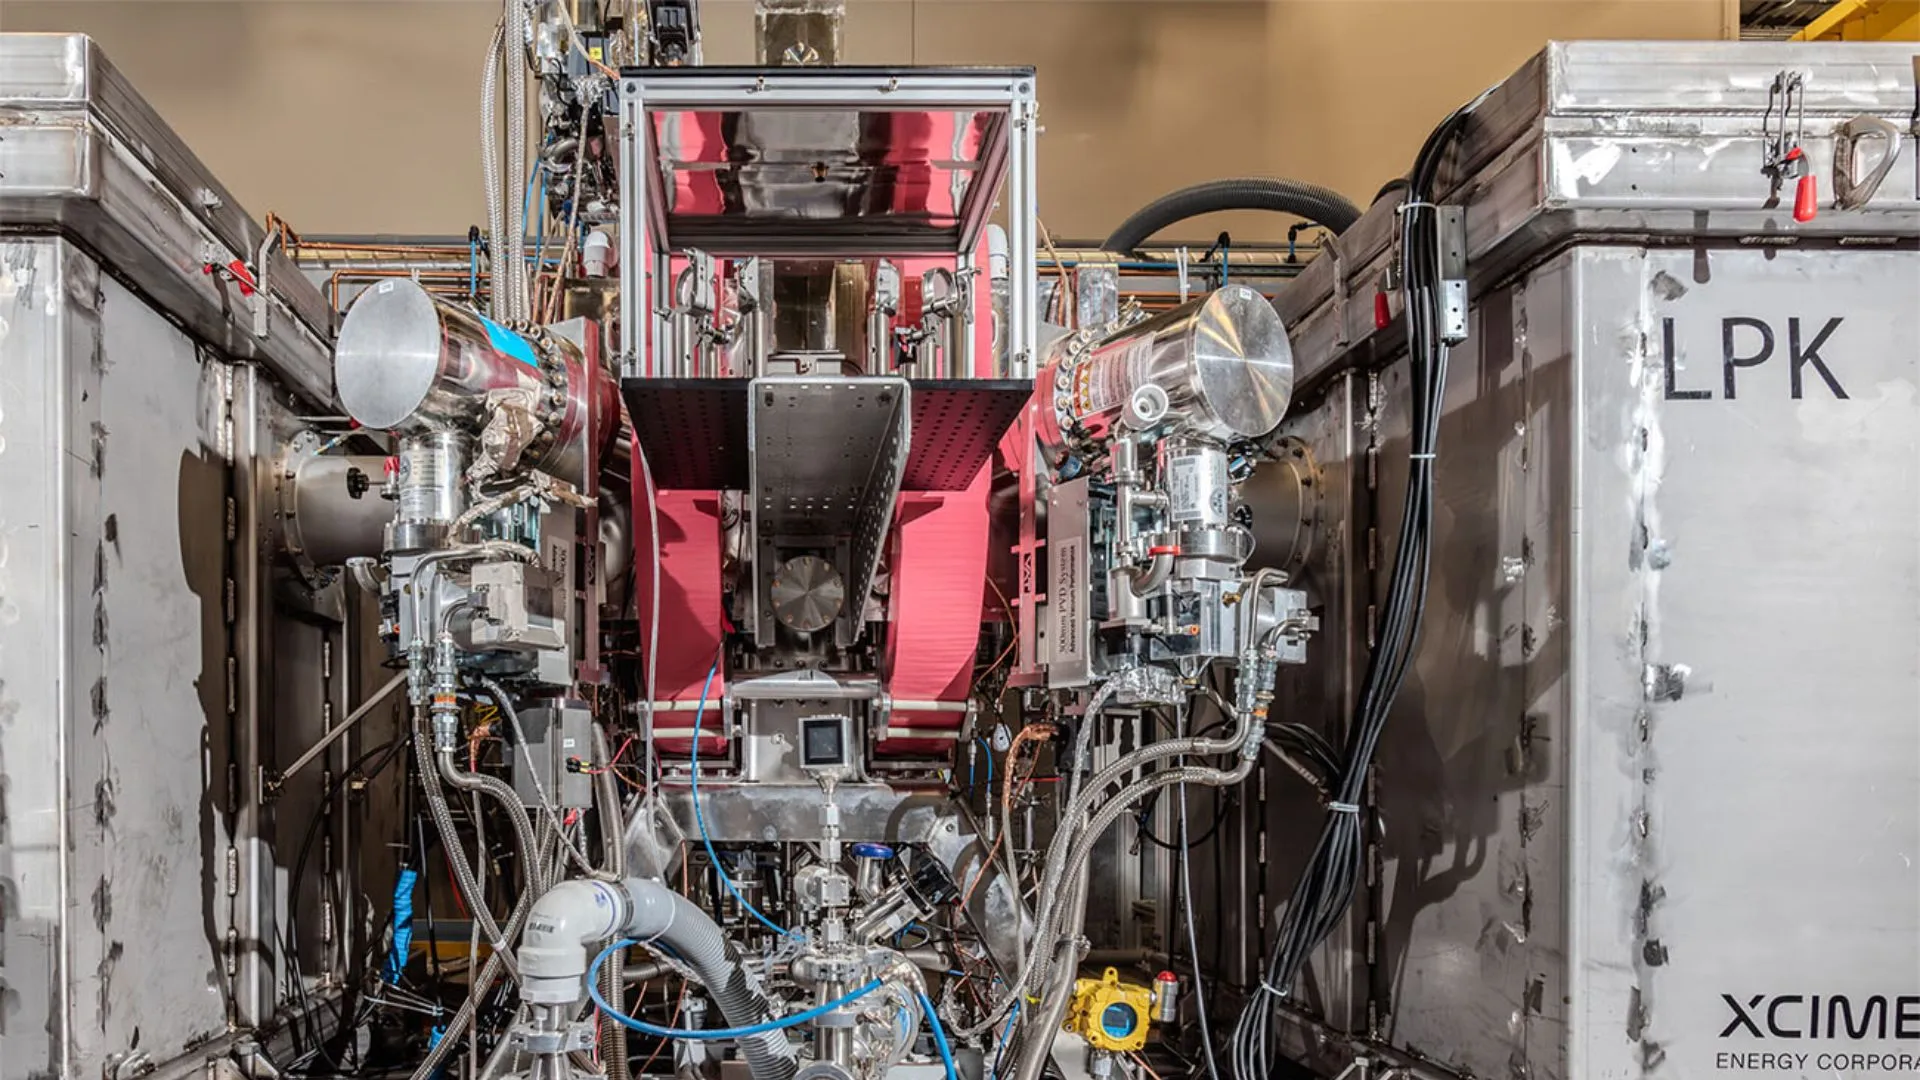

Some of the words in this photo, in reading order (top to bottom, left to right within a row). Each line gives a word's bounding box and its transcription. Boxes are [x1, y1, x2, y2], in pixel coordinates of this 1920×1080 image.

[1663, 317, 1850, 400] LPK
[1058, 547, 1069, 585] System
[1058, 587, 1066, 613] PVD
[1716, 1053, 1809, 1070] ENERGY
